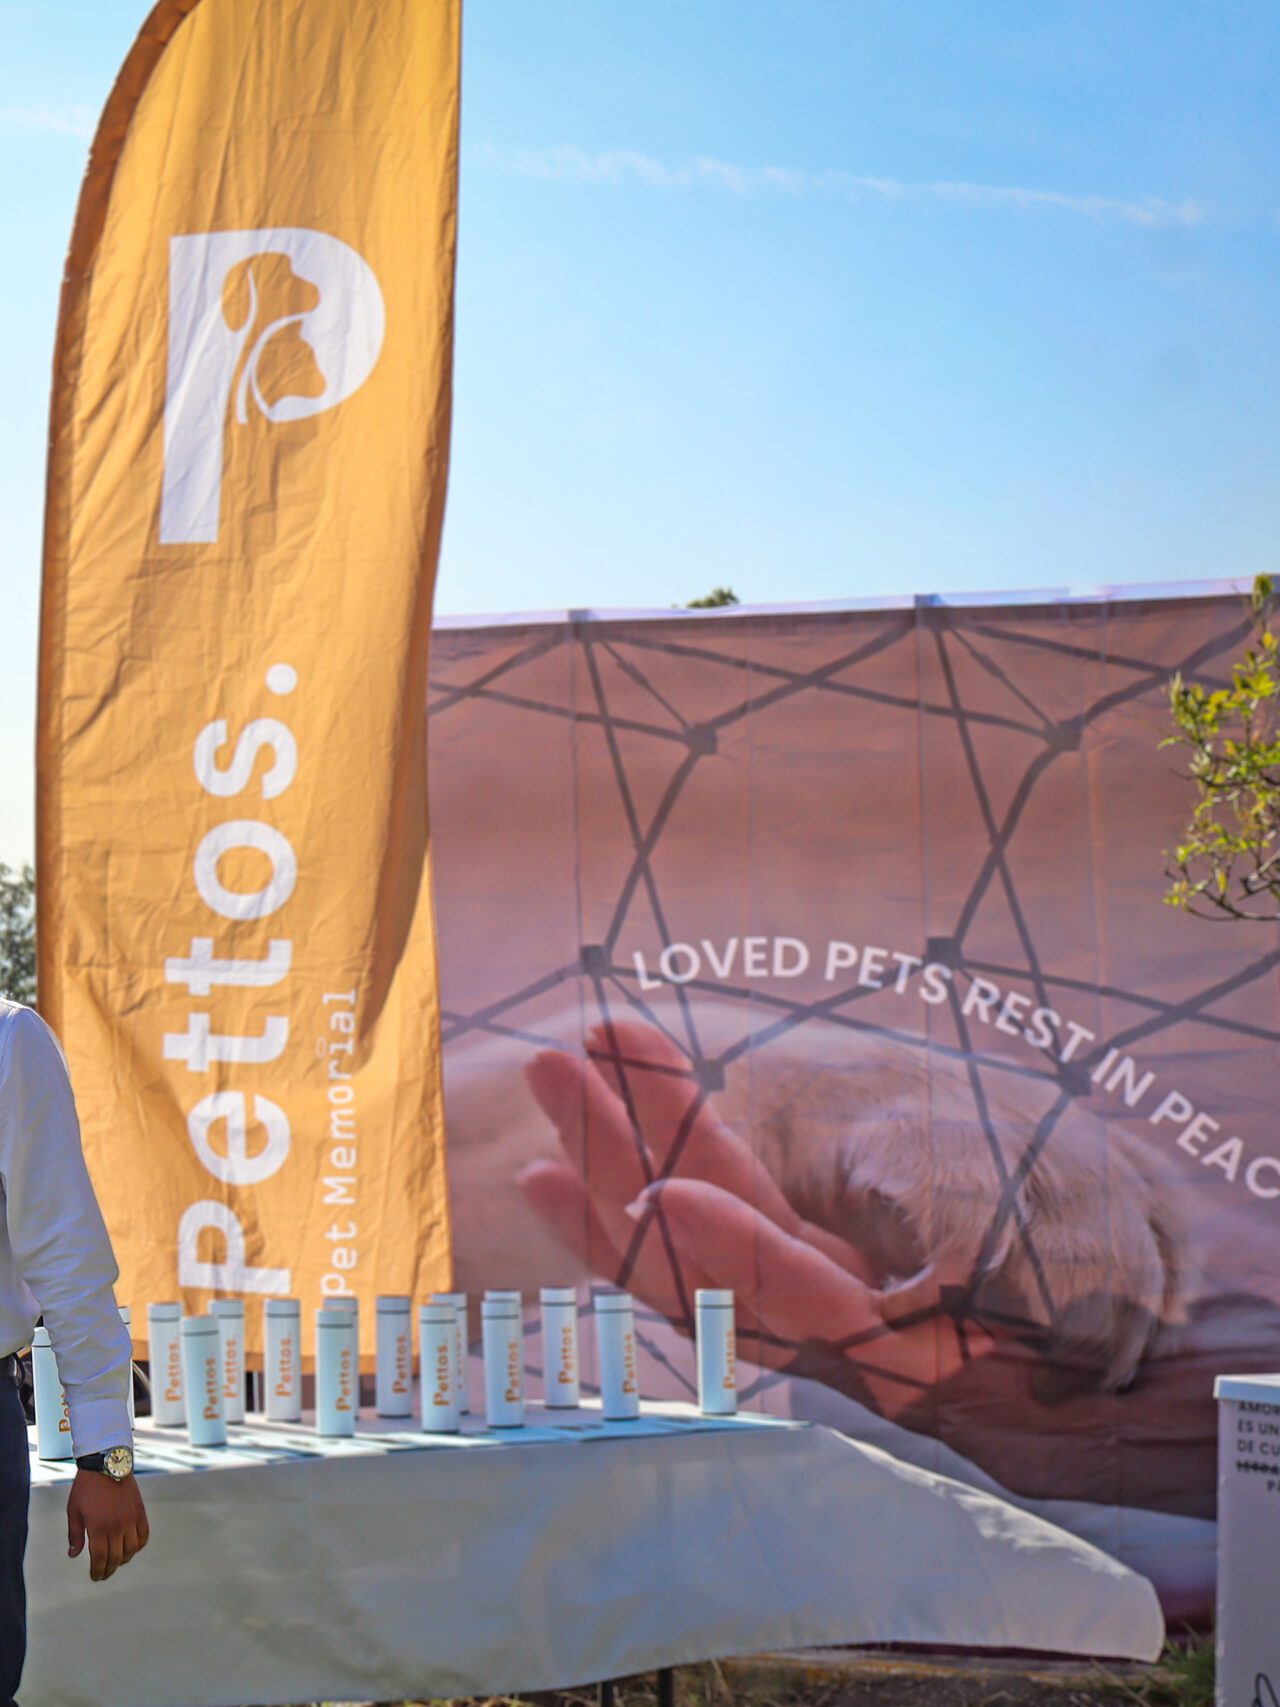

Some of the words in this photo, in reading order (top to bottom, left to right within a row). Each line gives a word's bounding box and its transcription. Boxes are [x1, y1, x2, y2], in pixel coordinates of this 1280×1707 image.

[163, 663, 298, 1294] Pettos.
[322, 987, 358, 1205] Memorial
[633, 936, 810, 991] LOVED
[824, 941, 953, 1005] PETS
[961, 977, 1095, 1064] REST
[1091, 1047, 1155, 1106] IN
[1149, 1089, 1280, 1199] PEAC
